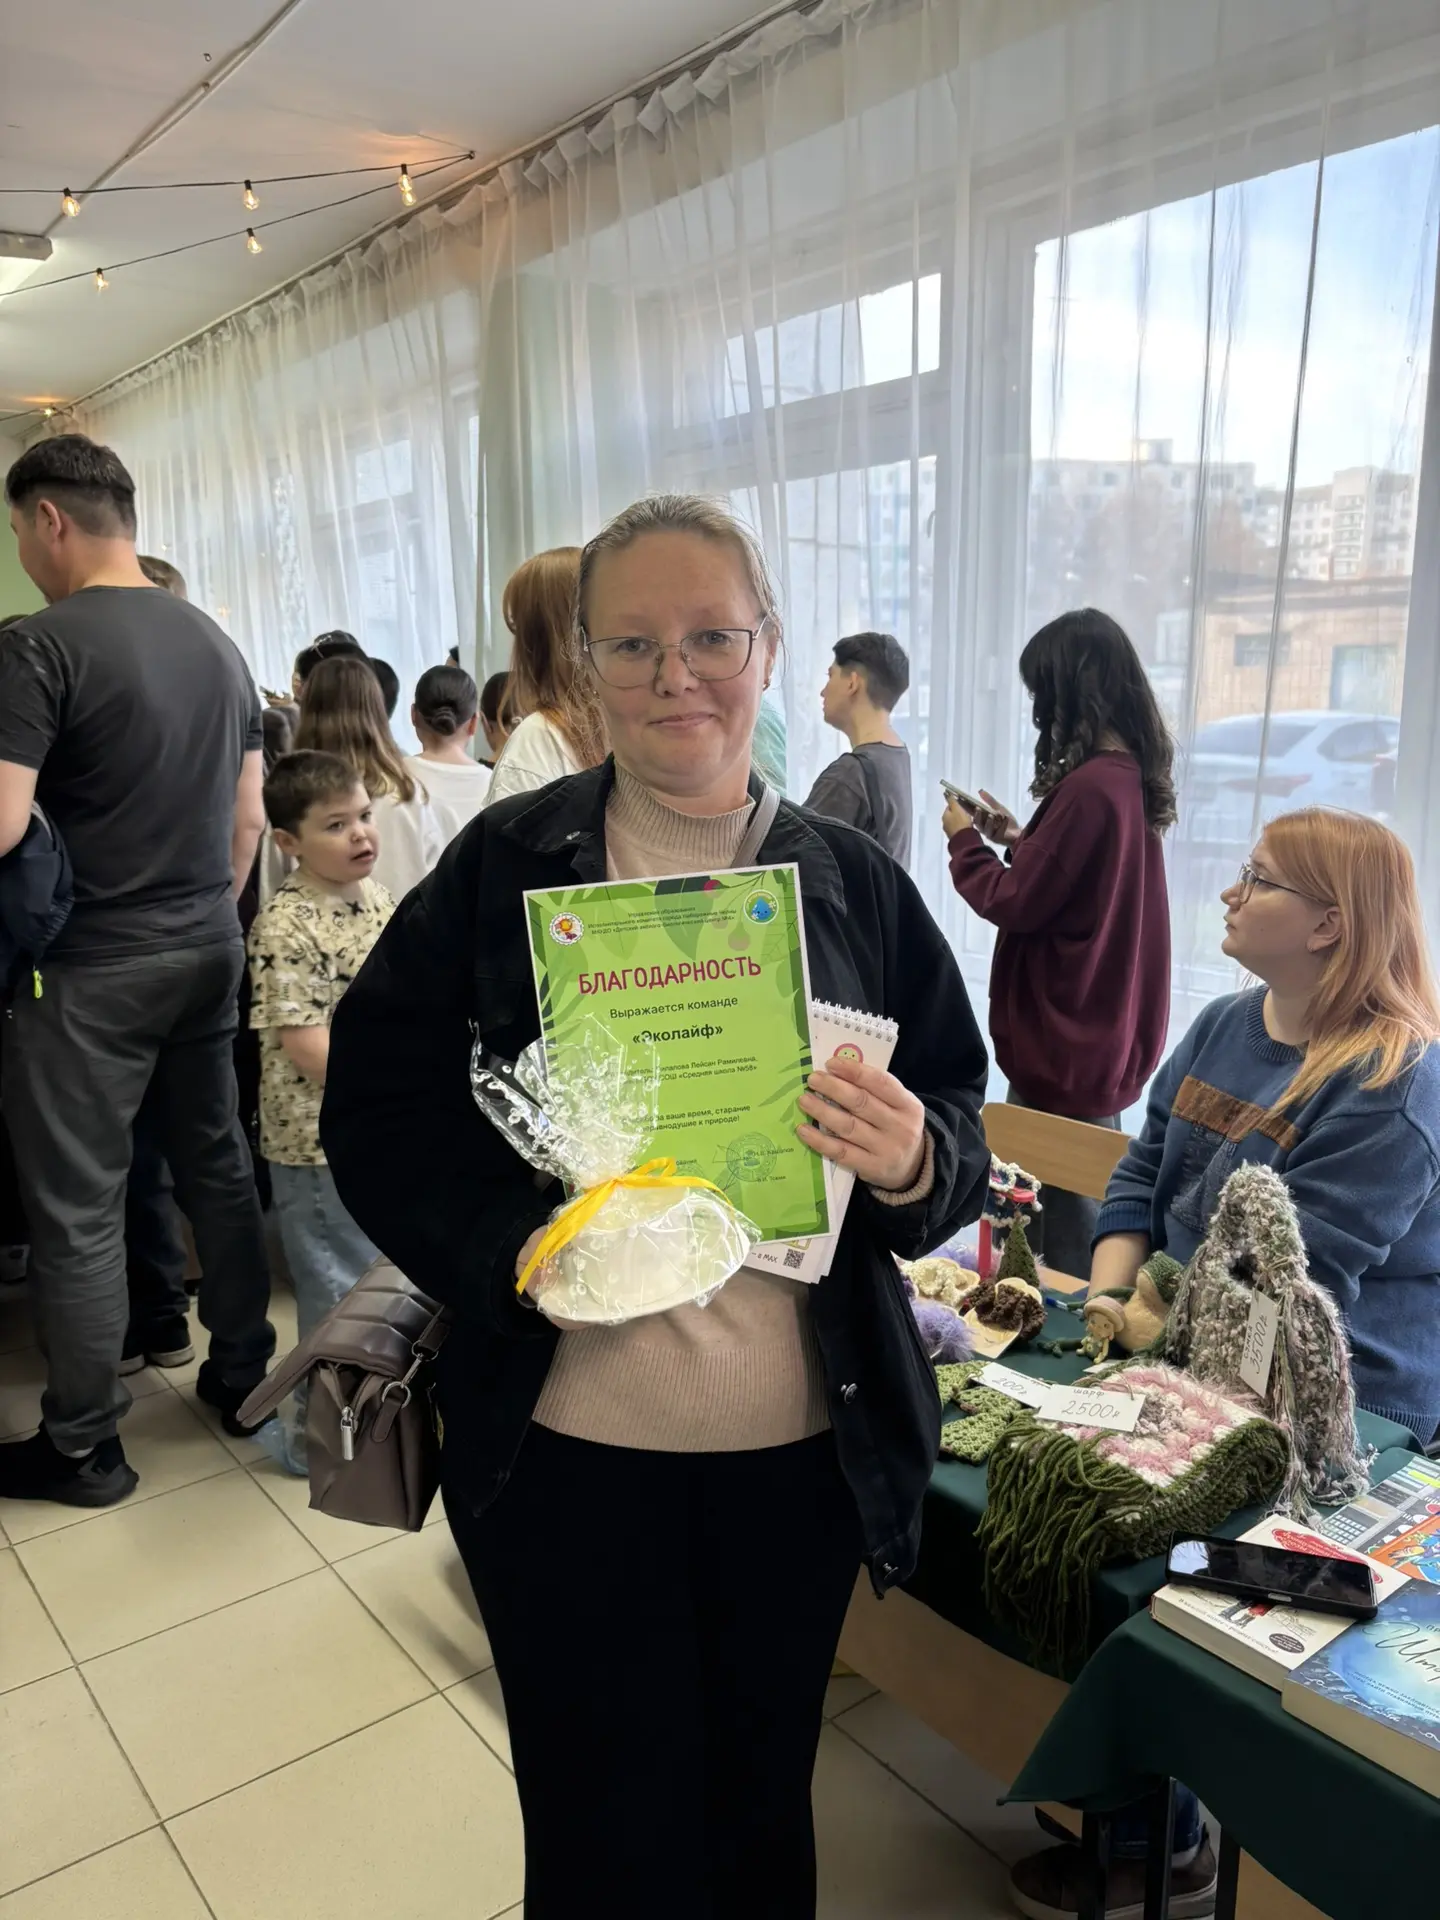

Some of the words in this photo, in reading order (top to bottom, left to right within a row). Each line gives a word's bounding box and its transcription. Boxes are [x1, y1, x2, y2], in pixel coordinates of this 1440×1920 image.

[578, 956, 762, 996] БЛАГОДАРНОСТЬ
[609, 1003, 685, 1020] Выражается
[687, 996, 739, 1012] команде
[632, 1024, 723, 1045] «Эколайф»
[666, 1112, 686, 1121] ваше
[687, 1108, 714, 1120] время,
[714, 1104, 751, 1116] старание
[1073, 1388, 1105, 1399] шарф
